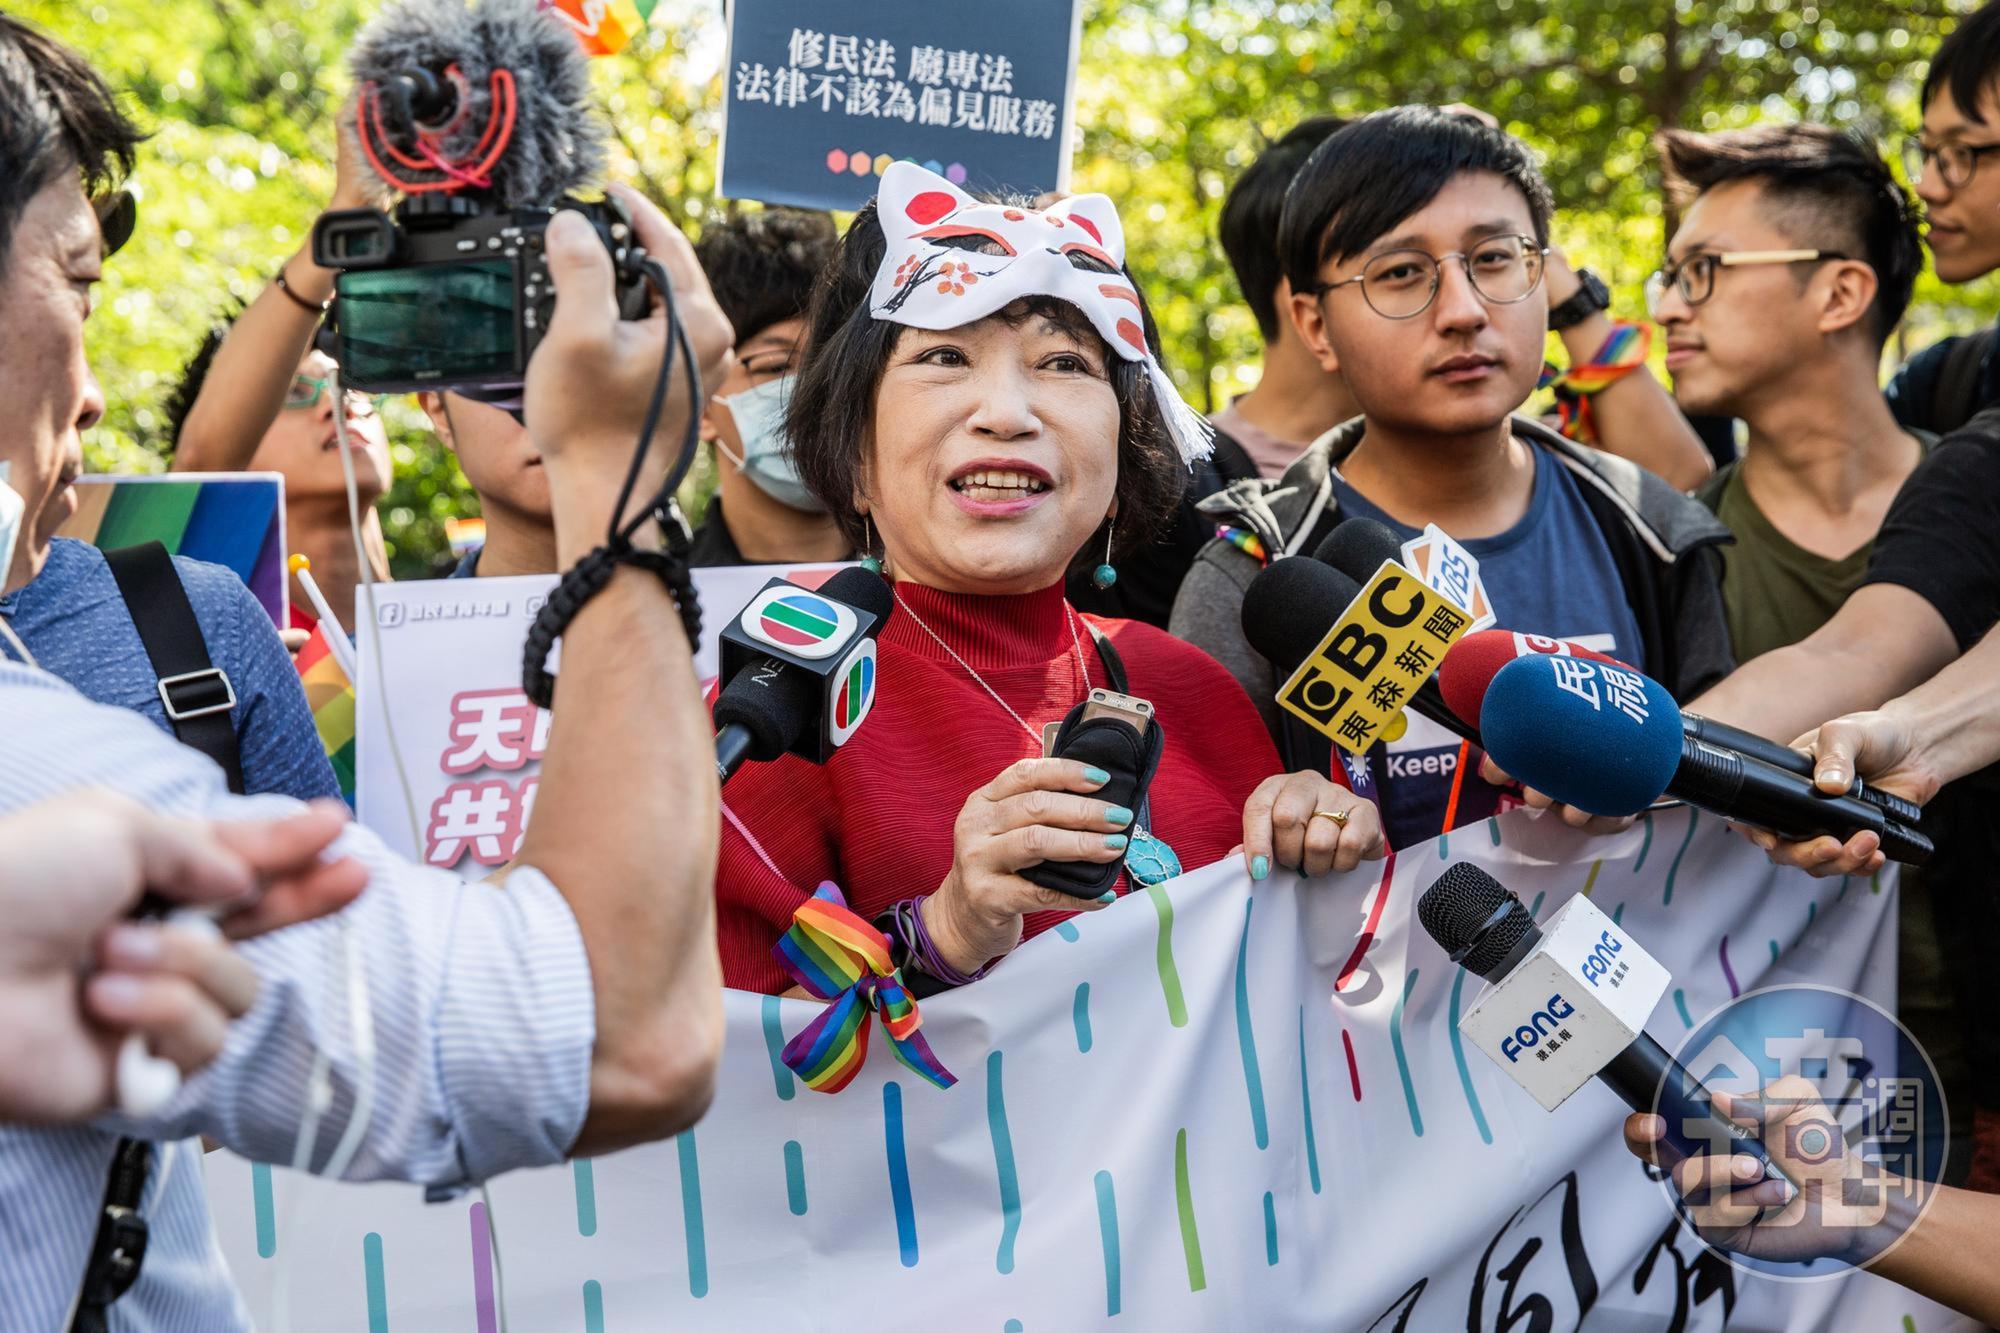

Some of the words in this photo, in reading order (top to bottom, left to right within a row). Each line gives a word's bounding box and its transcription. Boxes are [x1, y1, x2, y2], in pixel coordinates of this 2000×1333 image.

[788, 28, 897, 80] 修民法
[908, 45, 1014, 95] 廢專法
[735, 61, 1057, 140] 法律不該為偏見服務
[1285, 576, 1426, 727] EBC
[1336, 604, 1466, 748] 東森新聞
[1550, 656, 1650, 725] 民視
[1386, 752, 1457, 778] Keep
[429, 779, 540, 862] 共
[1581, 930, 1623, 988] FONG
[1501, 993, 1576, 1063] FONG
